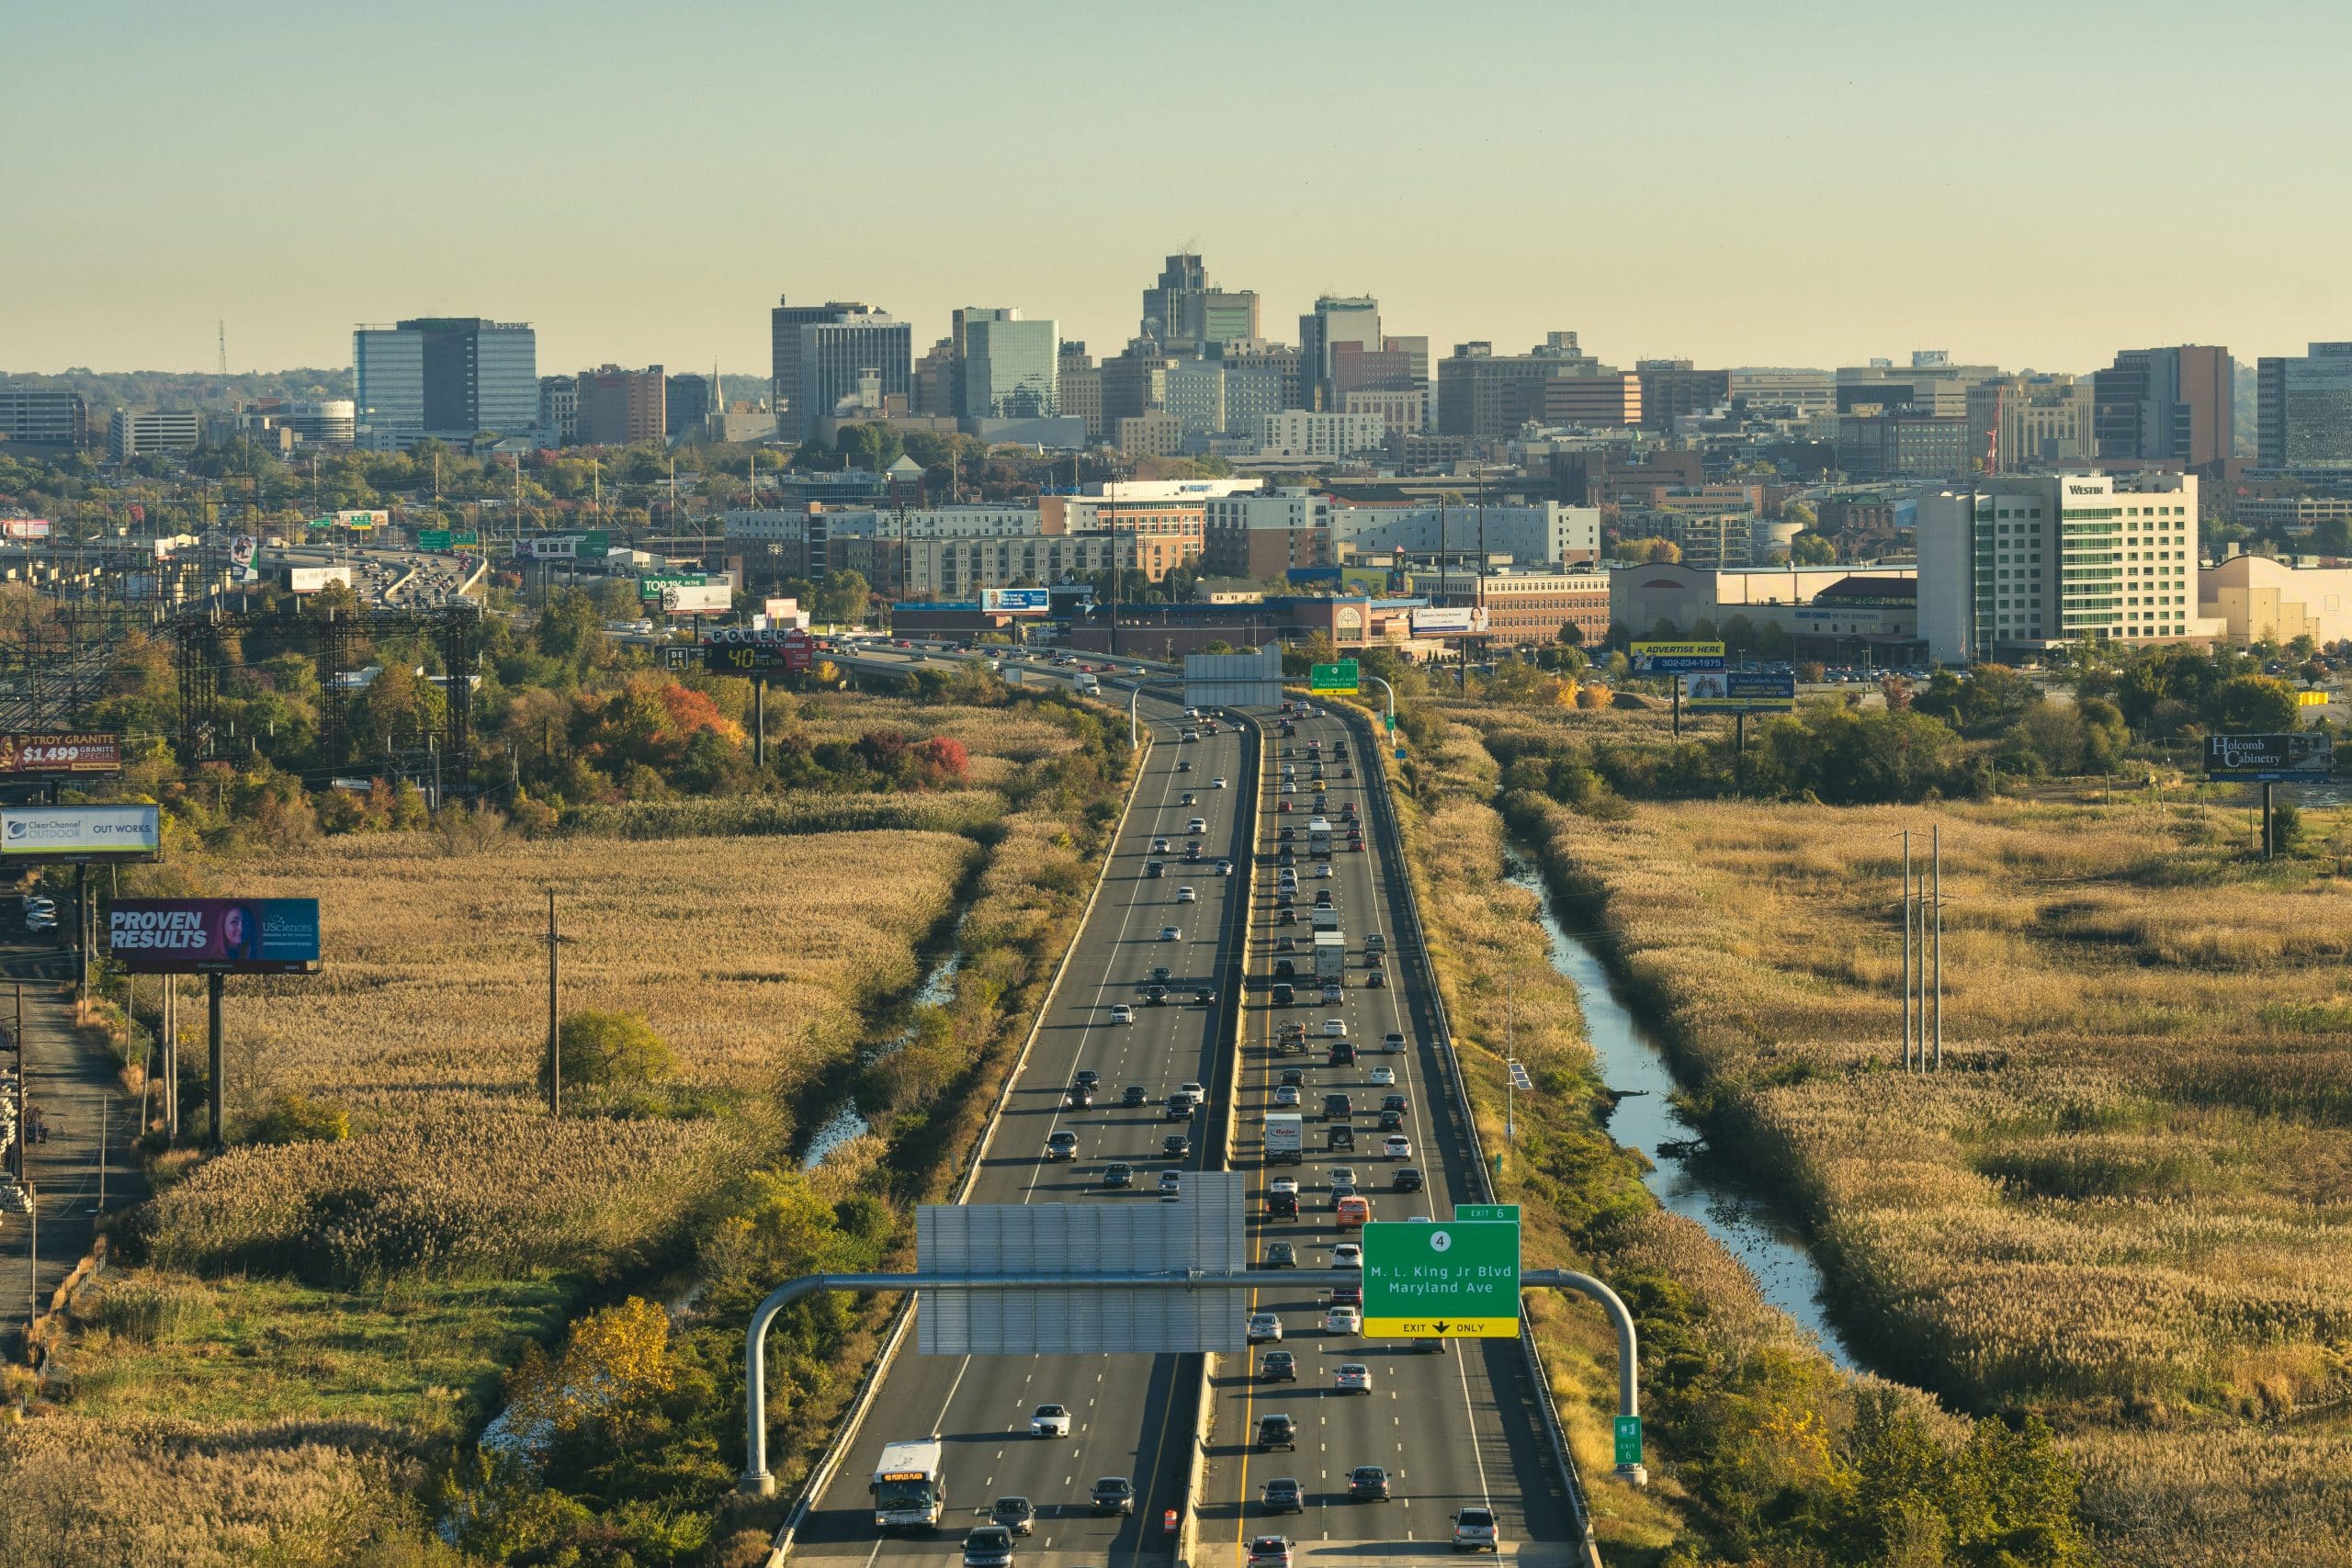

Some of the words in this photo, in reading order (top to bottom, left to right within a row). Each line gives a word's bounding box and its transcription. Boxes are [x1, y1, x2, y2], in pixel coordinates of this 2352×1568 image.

[644, 581, 666, 592] TOP
[713, 630, 786, 641] POWER
[1646, 646, 1695, 654] ADVERTISE
[1697, 646, 1721, 654] HERE
[728, 649, 755, 669] 40
[1661, 659, 1721, 668] 302-234-1975
[31, 735, 62, 745] TROY
[64, 734, 115, 745] GRANITE
[2211, 737, 2265, 755] Holcomb
[23, 746, 79, 763] $1,499
[2224, 750, 2281, 768] Cabinetry
[28, 820, 81, 829] ClearChannel
[93, 825, 112, 834] OUT
[115, 824, 153, 833] WORKS.
[28, 829, 81, 839] OUTDOOR
[110, 911, 202, 930] PROVEN
[263, 921, 312, 932] USciences
[110, 931, 208, 948] RESULTS
[1497, 1209, 1504, 1219] 6
[1436, 1235, 1444, 1247] 4
[1371, 1267, 1386, 1277] M.
[1395, 1267, 1406, 1277] L.
[1414, 1266, 1448, 1279] King
[1456, 1267, 1470, 1277] Jr
[1478, 1266, 1511, 1277] Blvd
[1389, 1282, 1458, 1295] Maryland
[1466, 1283, 1493, 1293] Ave
[1625, 1451, 1632, 1460] 6
